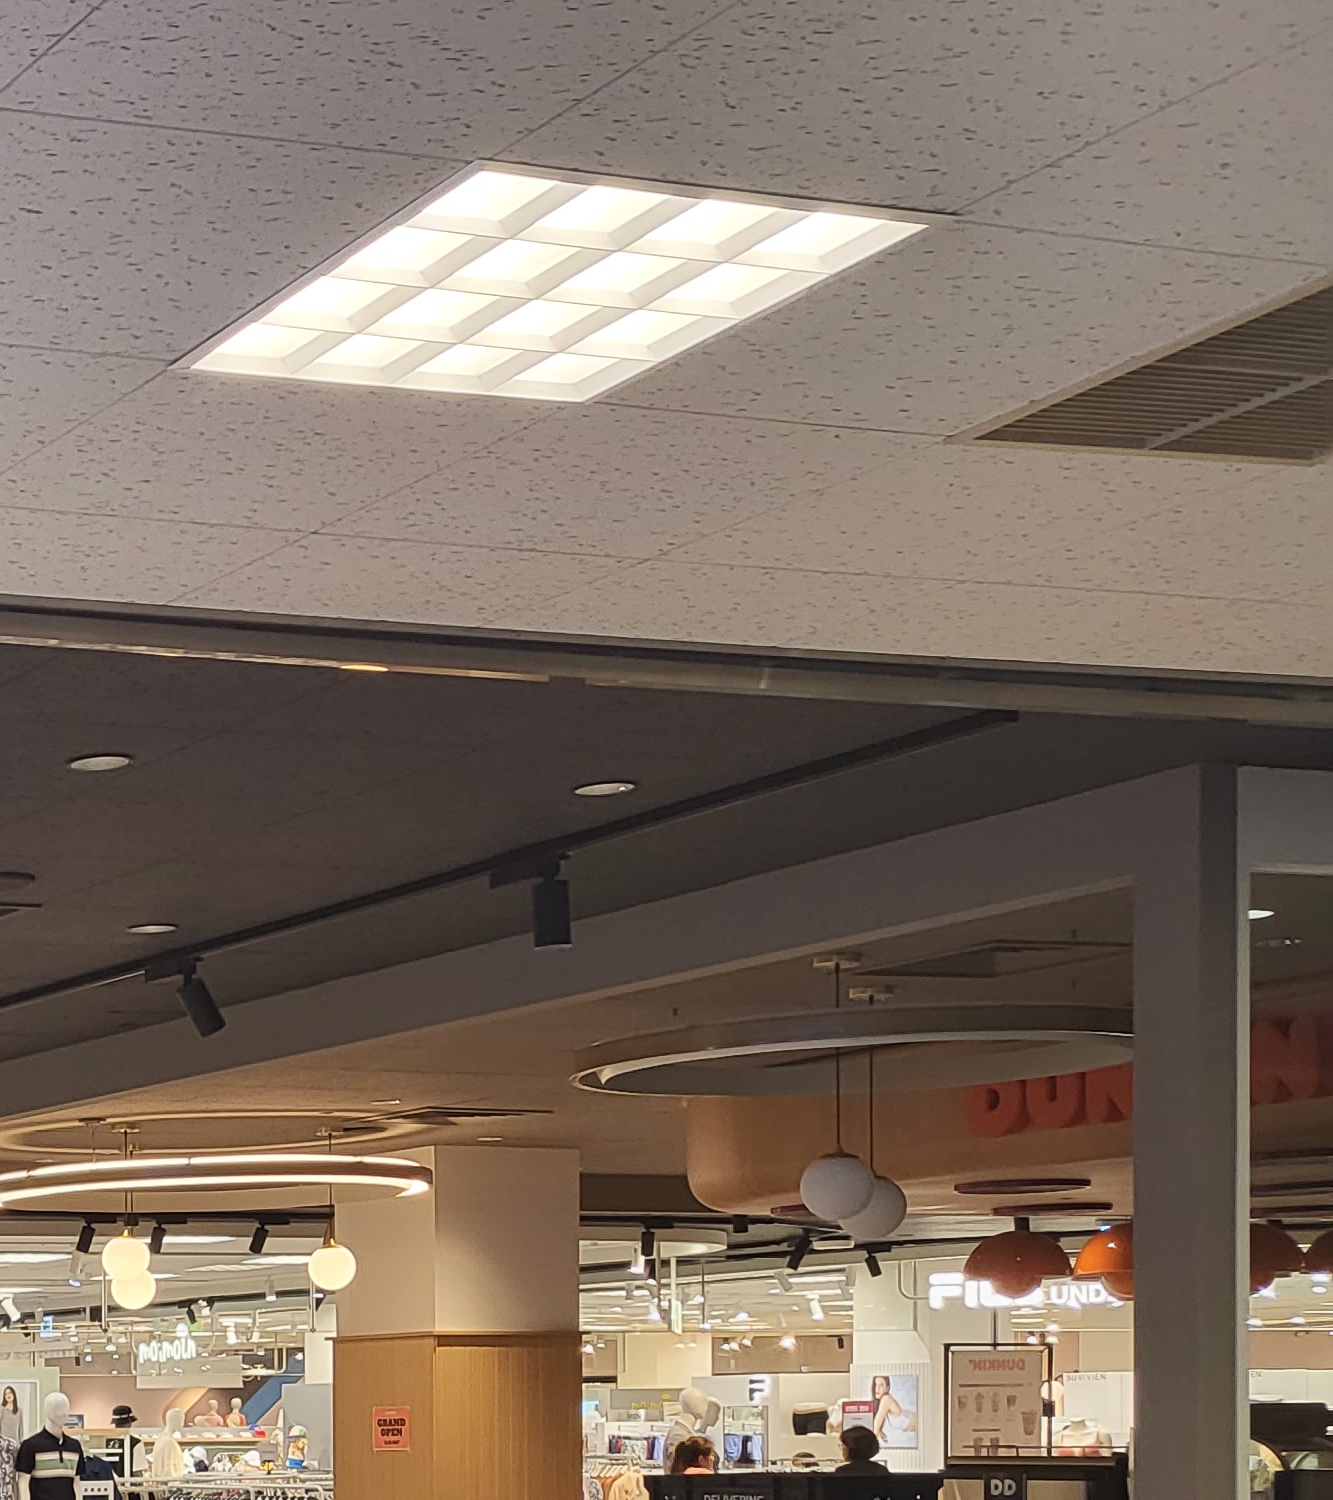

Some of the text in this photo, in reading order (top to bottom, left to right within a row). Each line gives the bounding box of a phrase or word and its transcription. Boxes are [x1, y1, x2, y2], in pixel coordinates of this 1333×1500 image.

[377, 1418, 406, 1427] GRAND
[380, 1428, 403, 1437] OPEN
[990, 1478, 1016, 1496] DD
